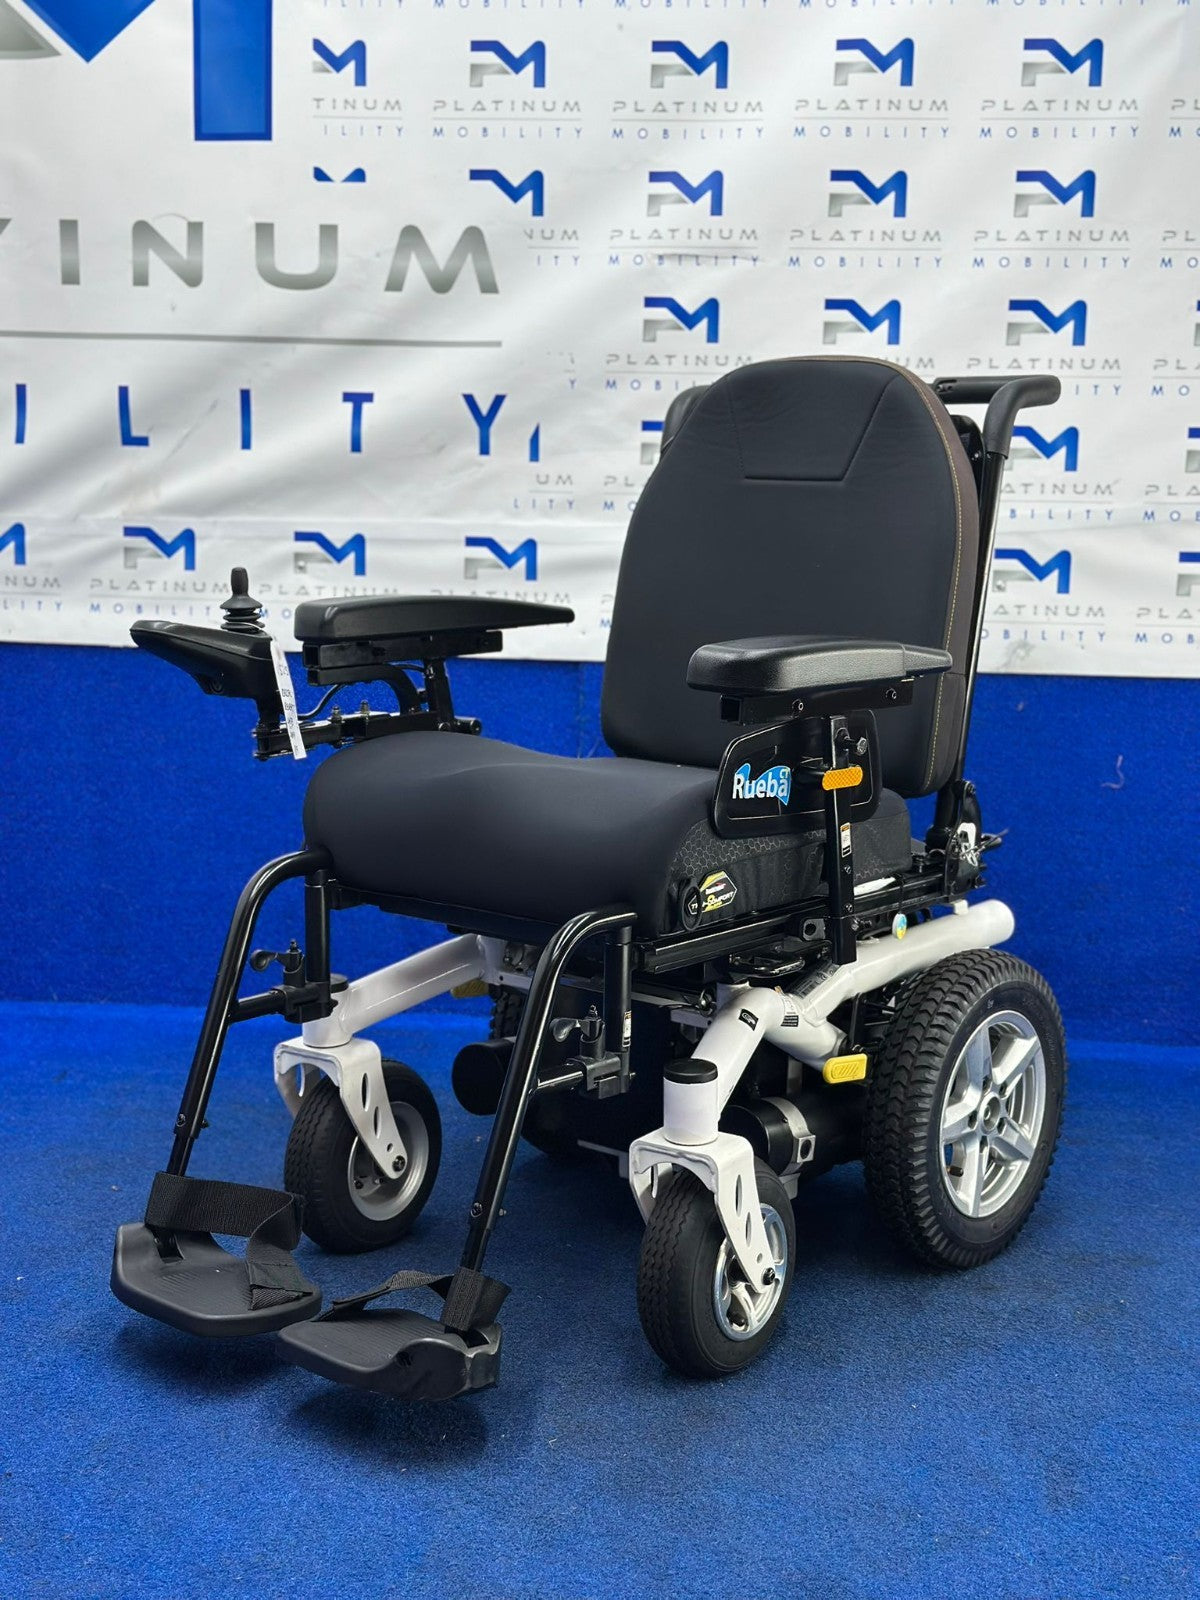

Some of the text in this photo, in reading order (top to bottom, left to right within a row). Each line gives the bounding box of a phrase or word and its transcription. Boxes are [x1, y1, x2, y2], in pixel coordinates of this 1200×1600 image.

[433, 100, 580, 112] PLATINUM
[613, 101, 763, 113] PLATINUM
[795, 99, 948, 111] PLATINUM
[981, 99, 1138, 111] PLATINUM
[433, 126, 582, 138] MOBILITY
[612, 127, 763, 140] MOBILITY
[794, 125, 949, 138] MOBILITY
[979, 126, 1139, 139] MOBILITY
[610, 228, 758, 240] PLATINUM
[790, 229, 941, 242] PLATINUM
[974, 230, 1129, 242] PLATINUM
[0, 218, 499, 294] INUM
[609, 255, 759, 266] MOBILITY
[788, 256, 942, 268] MOBILITY
[972, 256, 1129, 268] MOBILITY
[967, 358, 1120, 370] PLATINUM
[732, 771, 788, 799] Rueba
